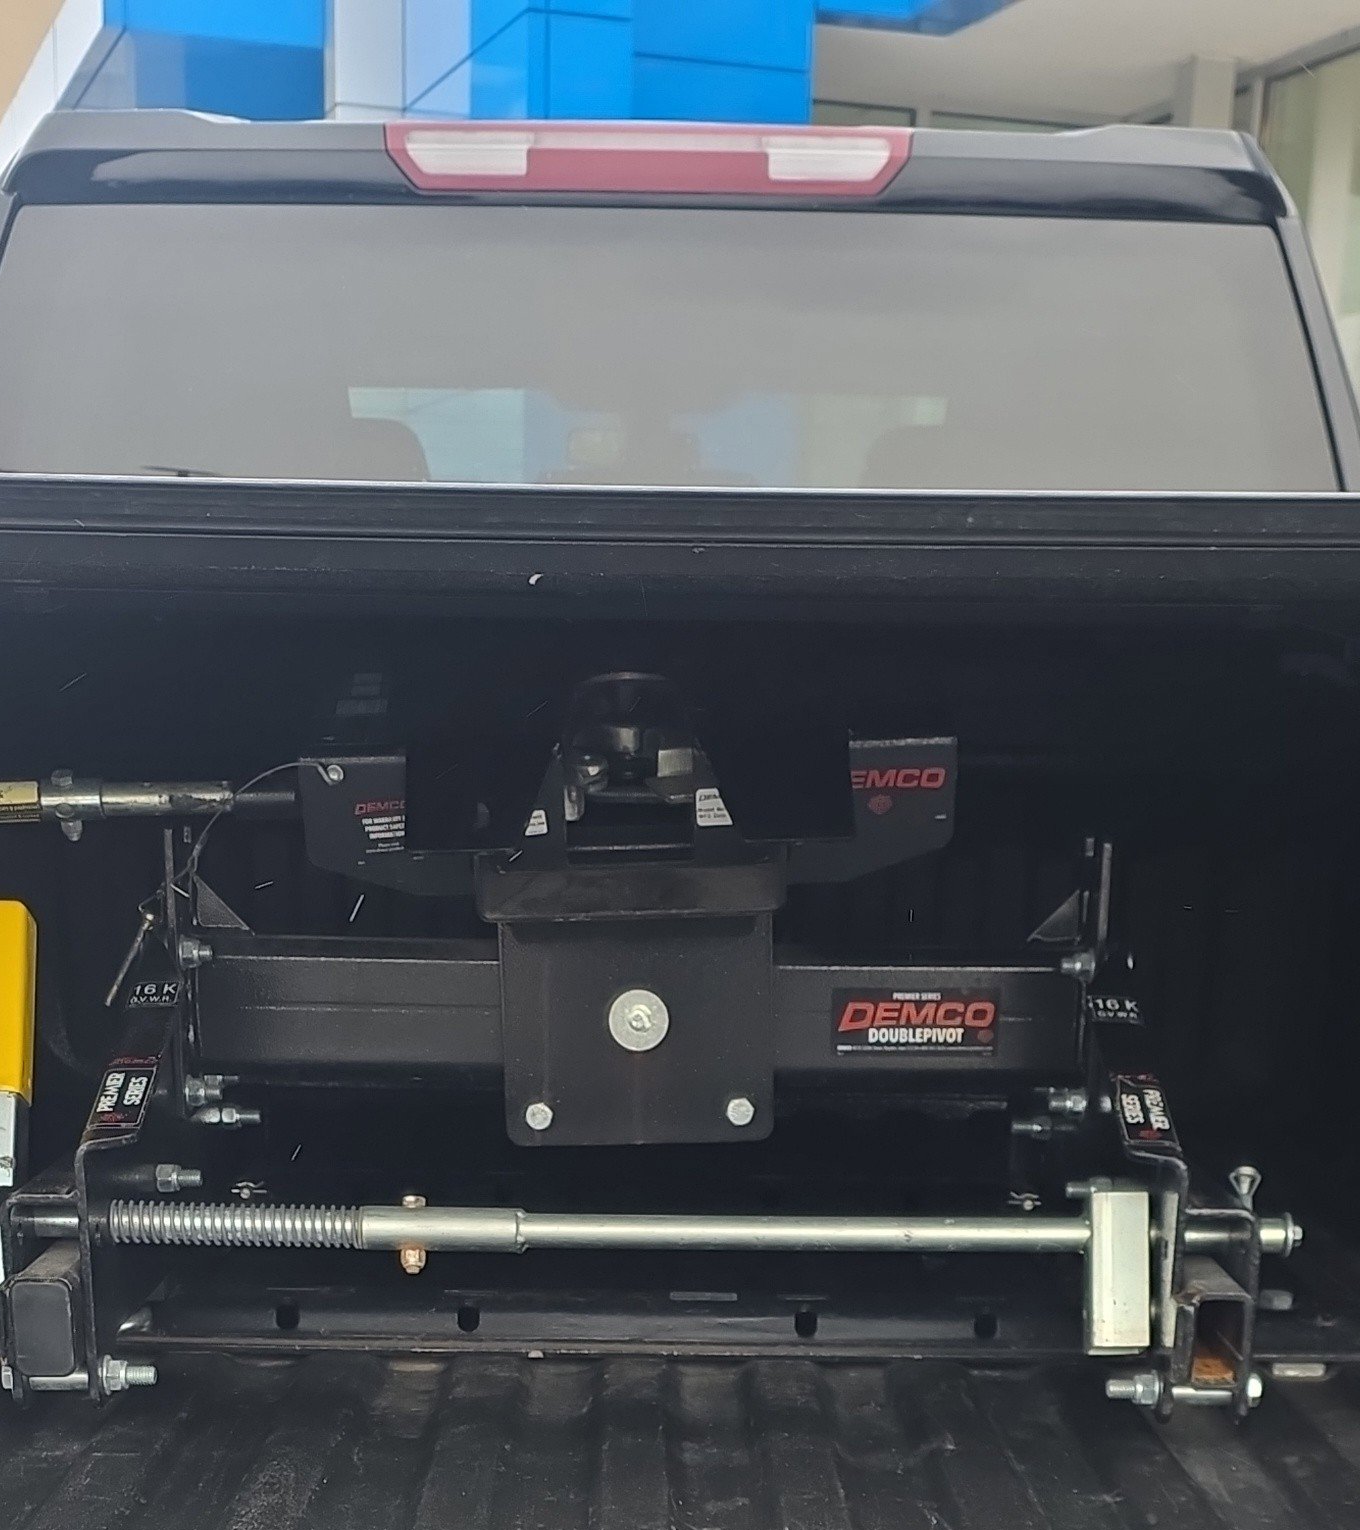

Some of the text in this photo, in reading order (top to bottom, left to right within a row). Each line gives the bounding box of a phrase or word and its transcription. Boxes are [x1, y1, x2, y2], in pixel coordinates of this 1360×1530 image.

[850, 767, 946, 789] EMCO
[134, 983, 177, 996] 16 K
[892, 992, 942, 1001] PREMIER SERIES
[837, 1001, 996, 1032] DEMCO
[1124, 998, 1139, 1013] K
[867, 1027, 965, 1043] DOUBLEPIVOT
[96, 1072, 126, 1113] PREMIER
[123, 1076, 148, 1106] SERIES
[1120, 1093, 1145, 1124] SERIES
[1142, 1088, 1171, 1131] PREMIER
